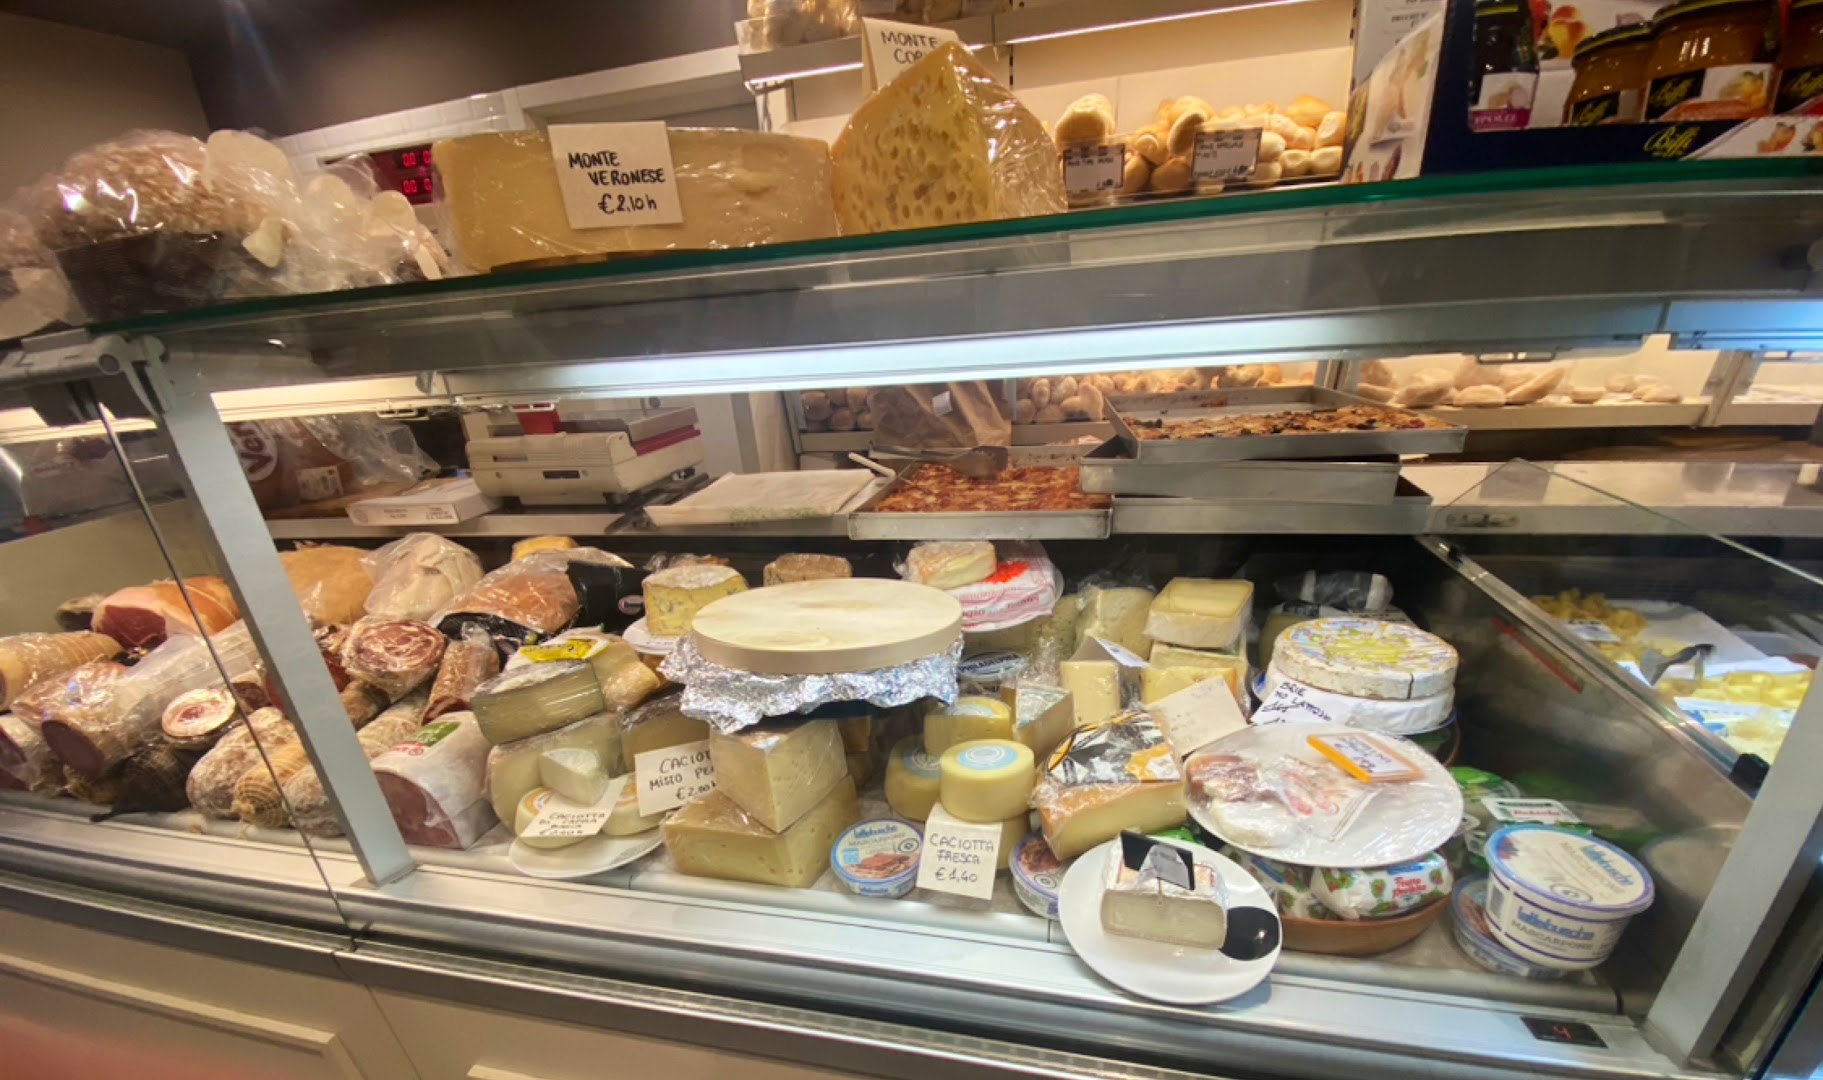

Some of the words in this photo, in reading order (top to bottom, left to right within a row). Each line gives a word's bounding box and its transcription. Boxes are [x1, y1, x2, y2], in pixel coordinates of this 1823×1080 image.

[881, 31, 937, 49] MONTE
[567, 150, 620, 169] MONTE
[587, 168, 666, 187] VERONESE
[929, 832, 995, 852] CACIOTTA
[936, 849, 981, 865] FRESCA
